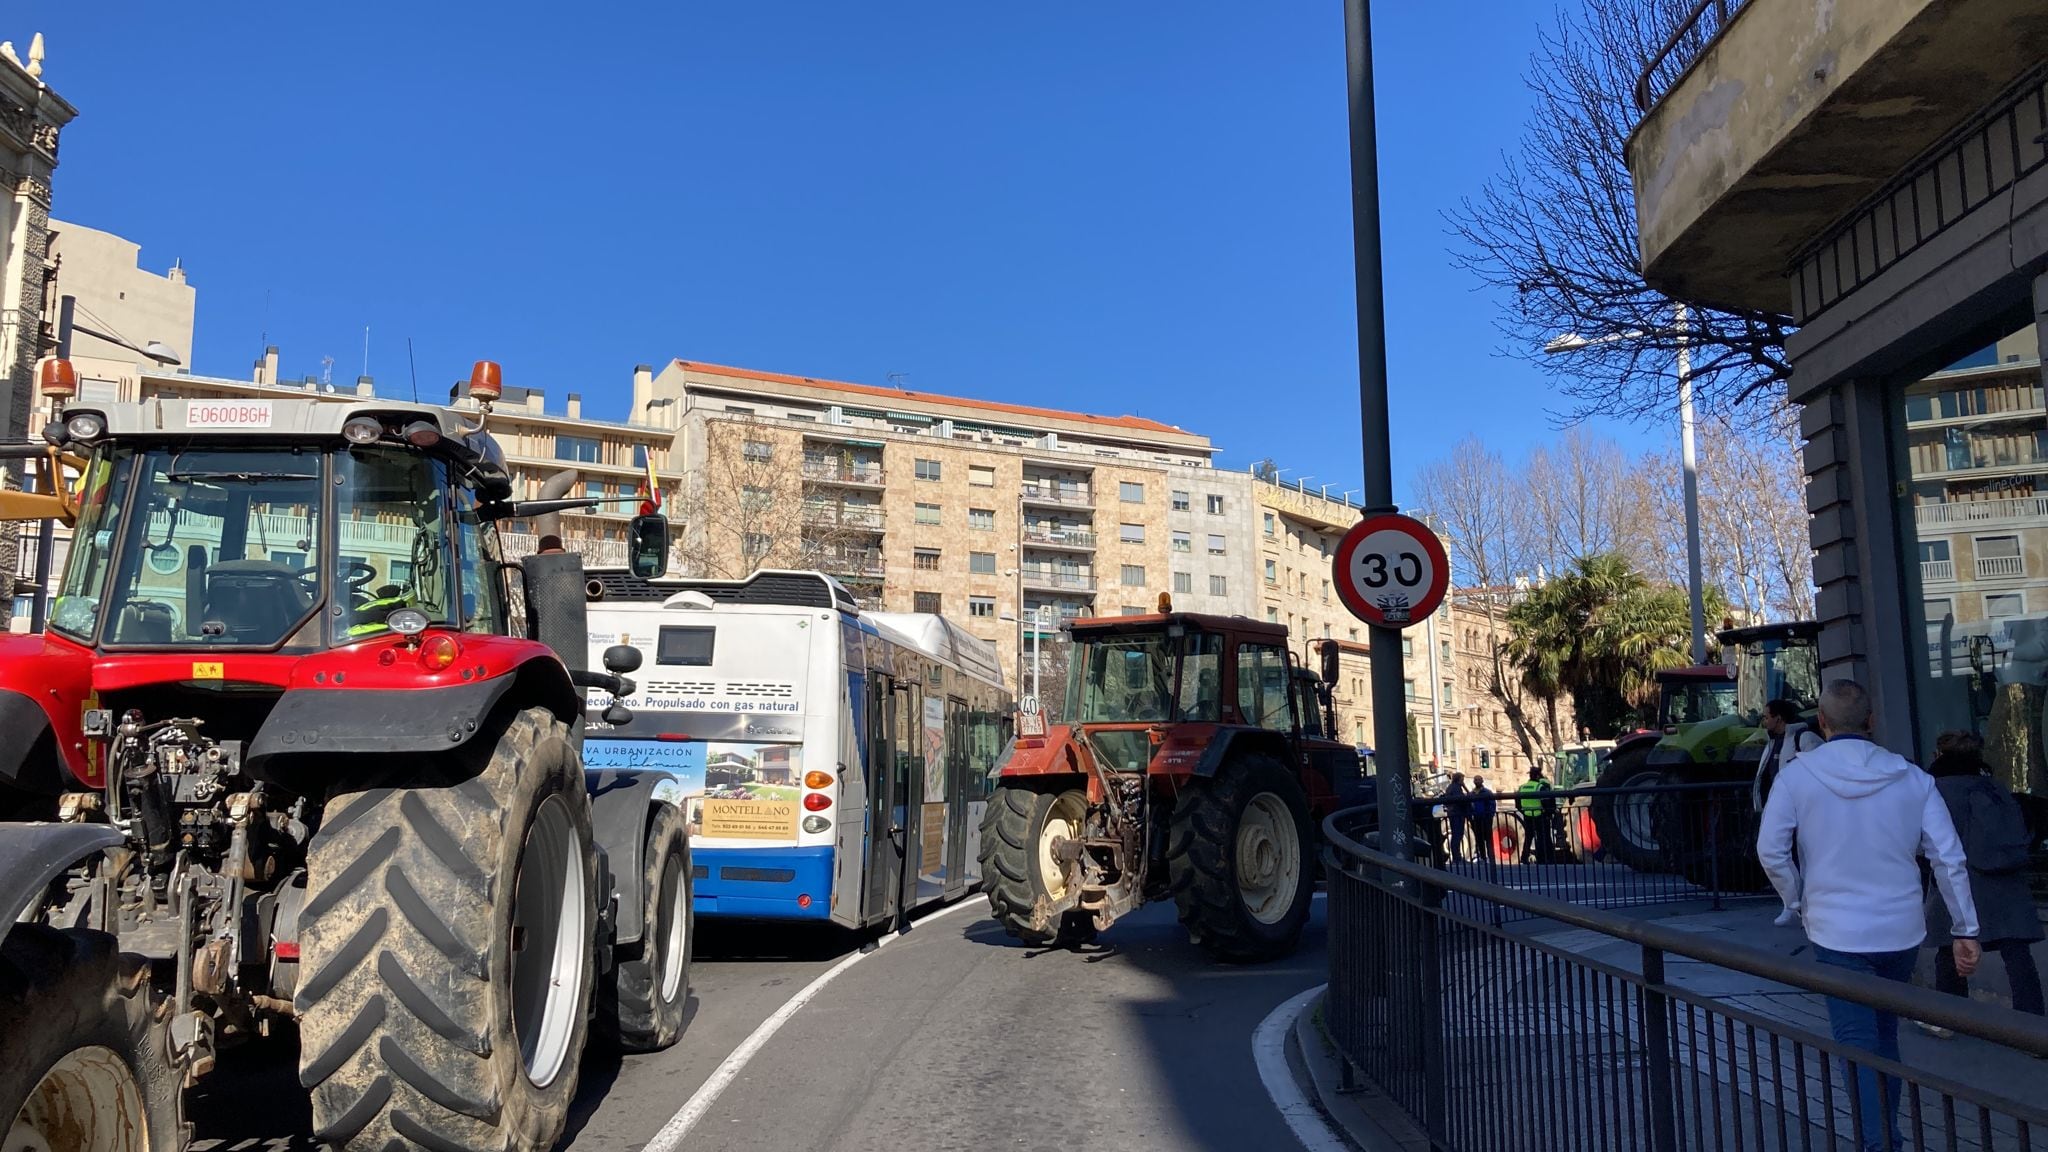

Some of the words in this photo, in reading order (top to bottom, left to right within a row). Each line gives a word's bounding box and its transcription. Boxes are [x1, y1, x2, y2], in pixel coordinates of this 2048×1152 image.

[1362, 552, 1423, 588] 30
[645, 696, 705, 710] Propulsado
[710, 700, 730, 709] con
[734, 700, 755, 711] gas
[759, 700, 799, 712] natural
[1023, 698, 1037, 715] 40
[604, 747, 692, 756] URBANIZACIÓN
[606, 759, 622, 767] de
[626, 753, 692, 769] Salamanca
[712, 805, 790, 816] MONTELLANO
